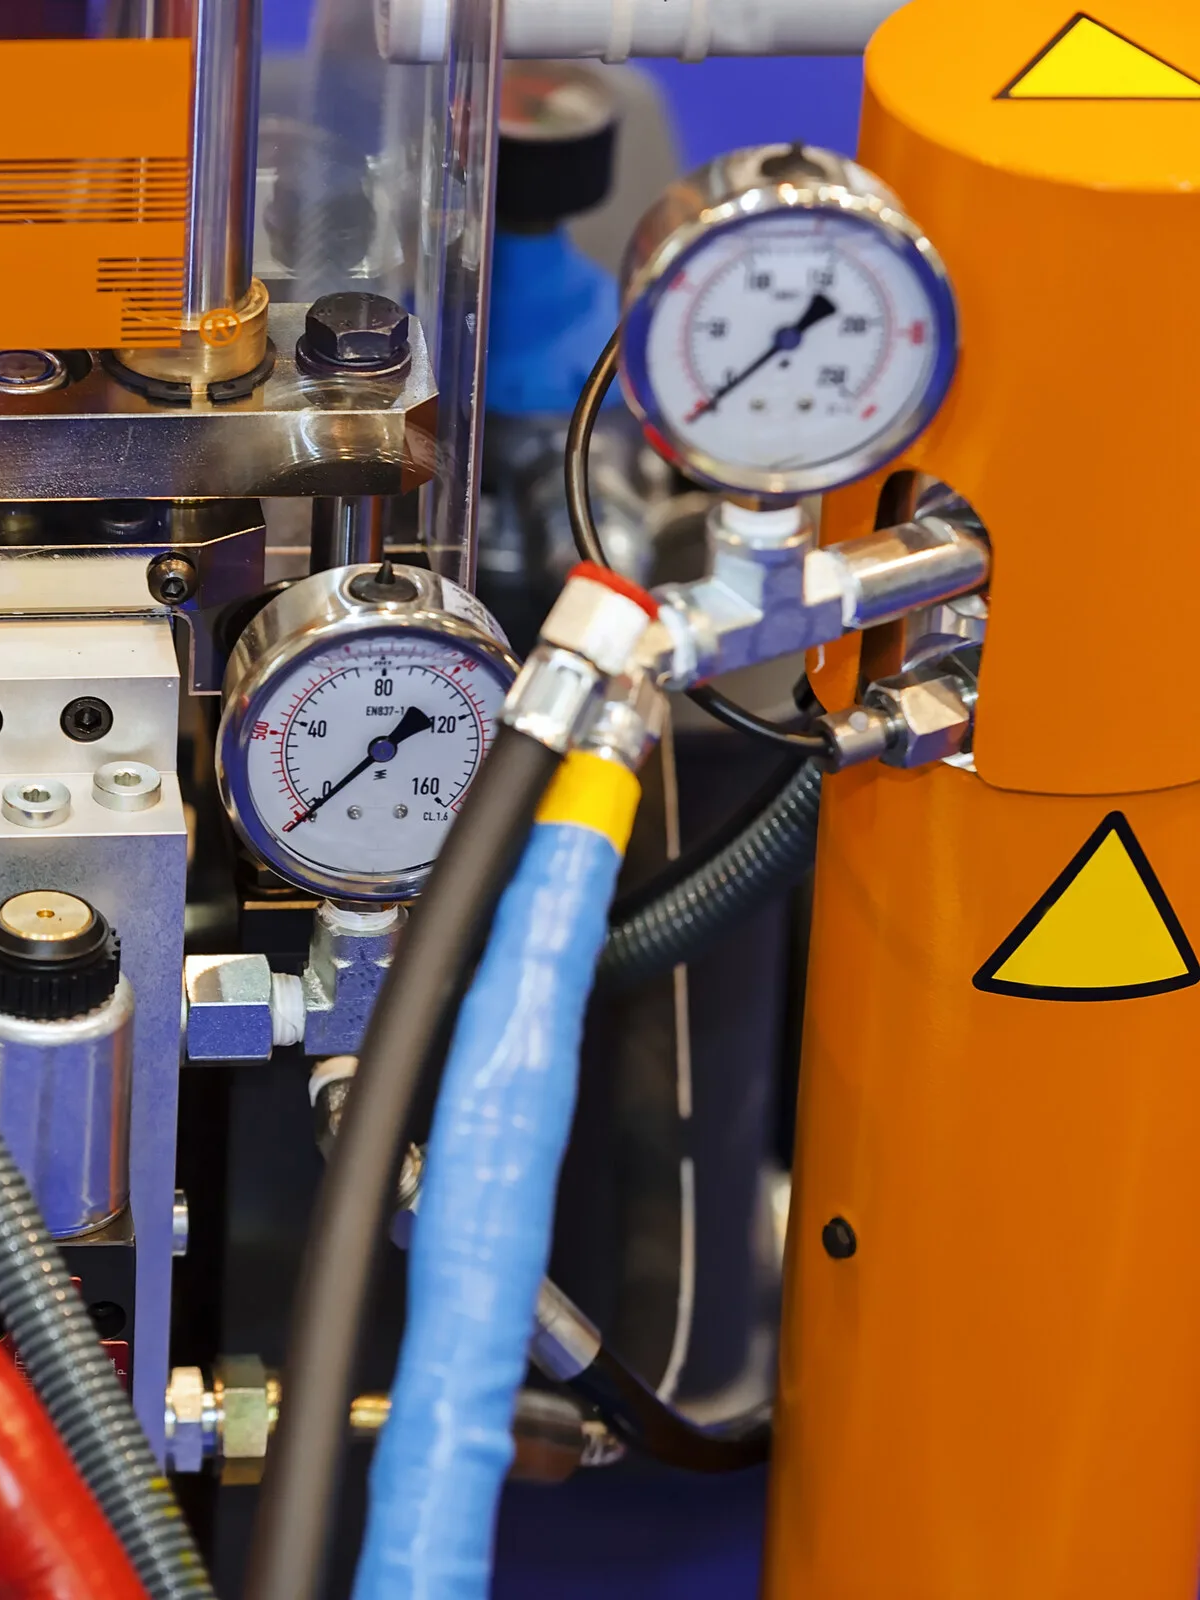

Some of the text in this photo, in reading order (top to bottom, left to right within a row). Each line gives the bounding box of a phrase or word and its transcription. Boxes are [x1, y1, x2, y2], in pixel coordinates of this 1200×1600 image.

[374, 678, 393, 696] 80
[366, 706, 405, 716] EN837-1
[251, 720, 270, 741] 500
[307, 720, 327, 738] 40
[428, 715, 457, 734] 120
[412, 777, 440, 796] 160
[423, 811, 449, 821] CL.1.6
